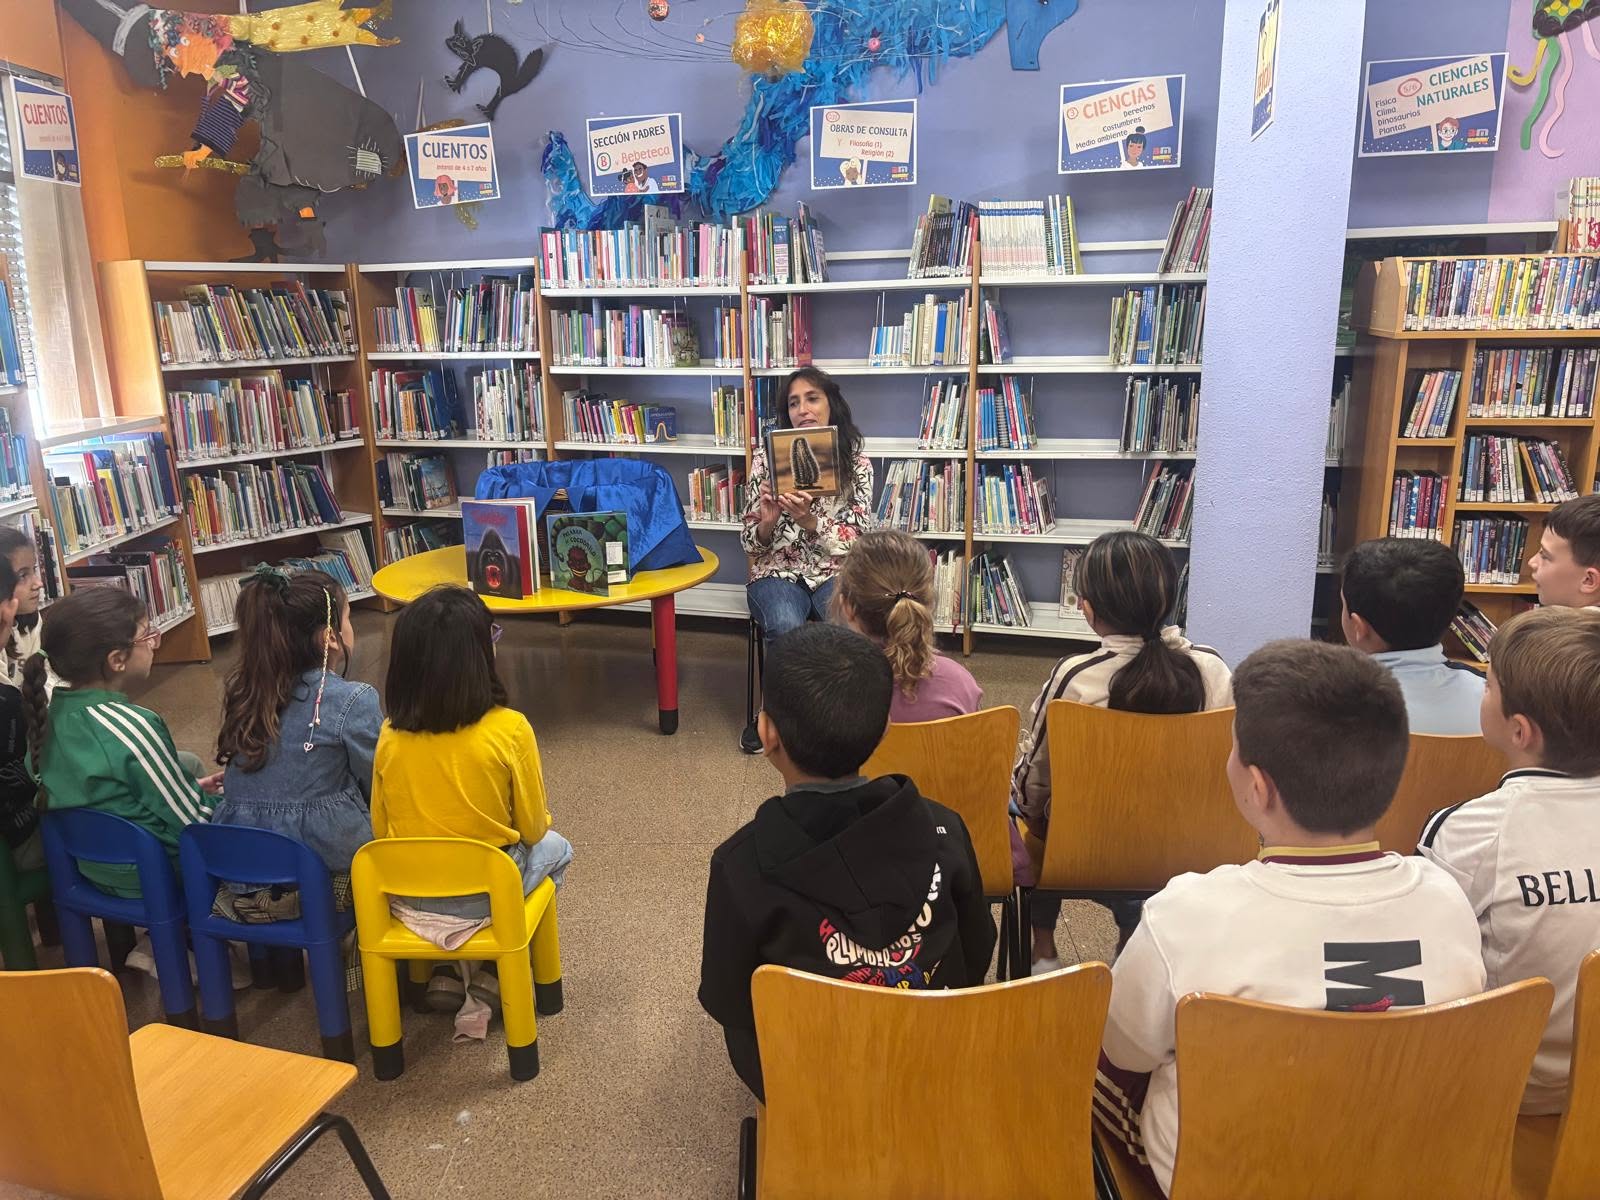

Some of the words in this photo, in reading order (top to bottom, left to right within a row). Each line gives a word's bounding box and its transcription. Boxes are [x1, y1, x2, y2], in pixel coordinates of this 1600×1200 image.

[1429, 60, 1489, 87] CIENCIAS
[1082, 84, 1157, 119] CIENCIAS
[1416, 78, 1489, 108] NATURALES
[1123, 103, 1155, 118] Derechos
[1375, 97, 1397, 108] Física
[23, 103, 68, 125] CUENTOS
[1376, 107, 1397, 117] Clima
[1377, 109, 1421, 127] Dinosaurios
[830, 123, 854, 133] OBRAS
[856, 125, 867, 135] DE
[868, 126, 908, 137] CONSULTA
[1102, 116, 1142, 133] Costumbres
[1378, 123, 1407, 136] Plantas
[593, 131, 630, 149] SECCIÓN
[632, 124, 666, 141] PADRES
[874, 140, 882, 149] (1)
[1075, 138, 1096, 150] Medio
[1097, 129, 1128, 143] ambiente
[422, 141, 488, 160] CUENTOS
[600, 155, 608, 168] B
[621, 146, 670, 164] Bebeteca
[885, 150, 894, 158] (2)
[1516, 868, 1600, 907] BELL
